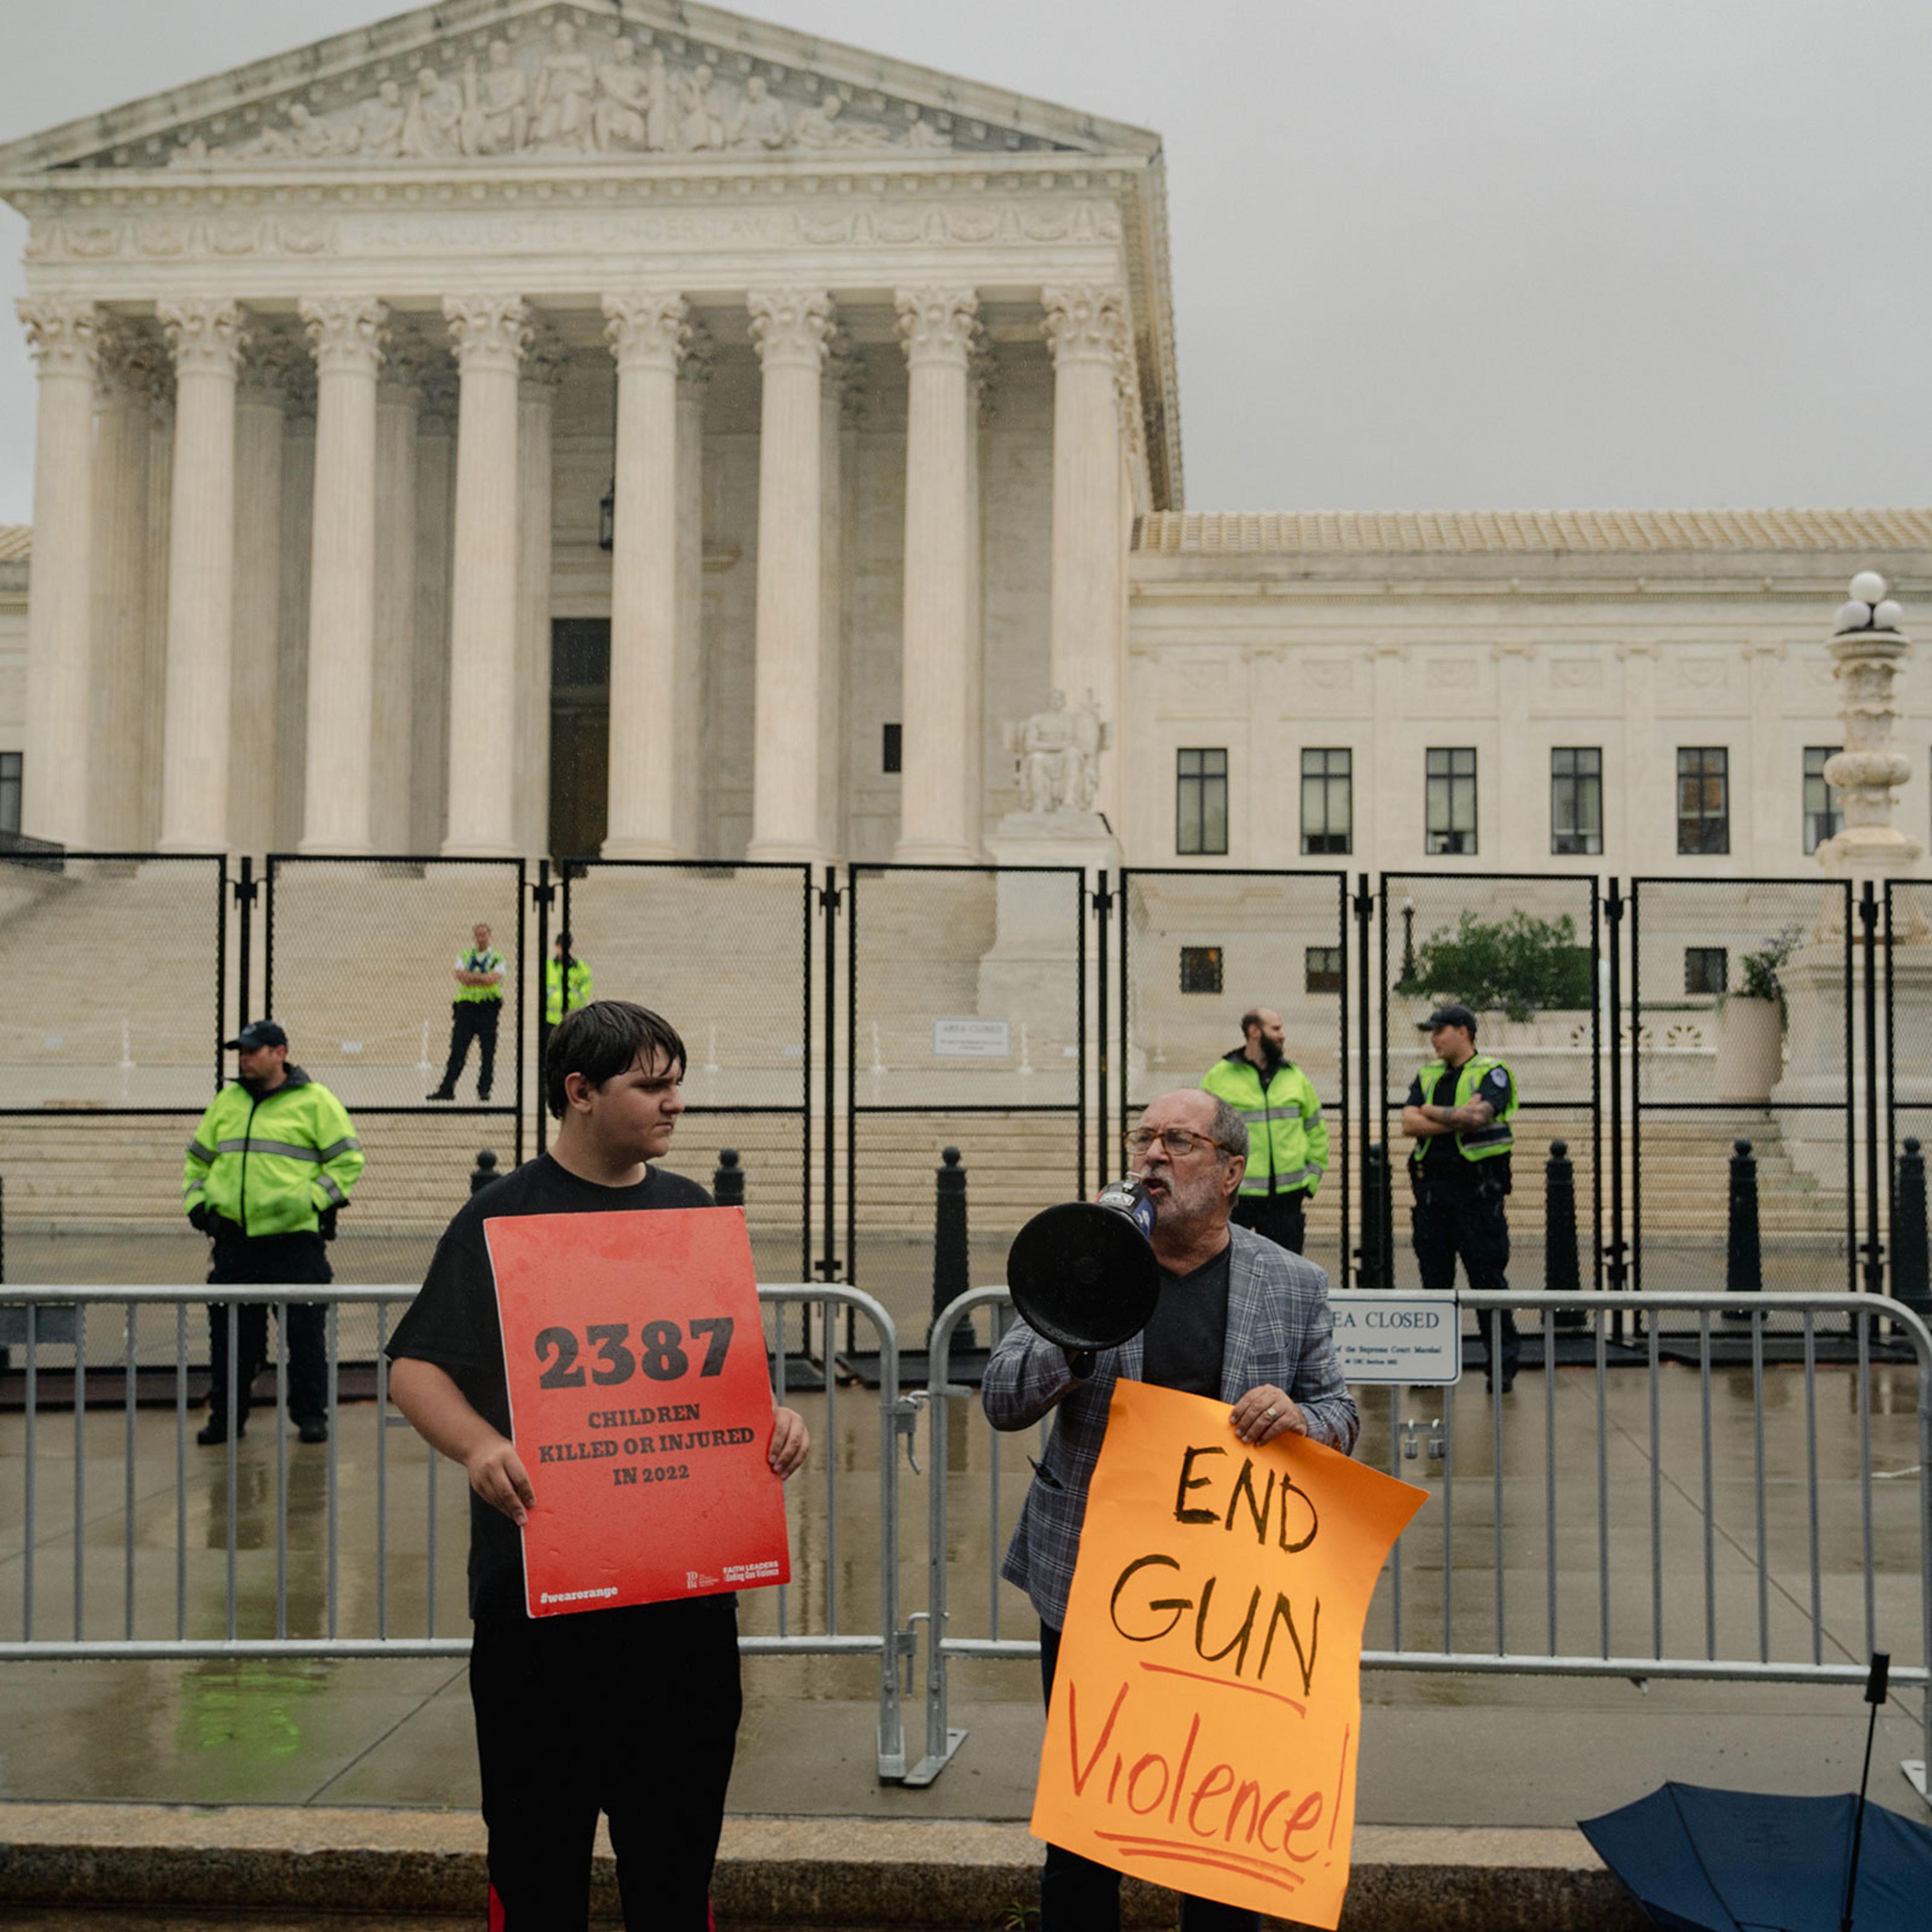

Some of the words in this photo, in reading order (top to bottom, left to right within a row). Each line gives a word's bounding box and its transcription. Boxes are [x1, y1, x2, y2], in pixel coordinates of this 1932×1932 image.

[1333, 1311, 1356, 1328] EA
[1365, 1312, 1439, 1328] CLOSED
[534, 1317, 734, 1390] 2387
[588, 1404, 700, 1428] CHILDREN
[539, 1440, 618, 1464] KILLED
[624, 1436, 655, 1455] OR
[659, 1427, 754, 1452] INJURED
[613, 1467, 637, 1485] IN
[642, 1465, 689, 1483] 2022
[1173, 1446, 1318, 1554] END
[723, 1565, 744, 1573] FAITH
[746, 1561, 779, 1571] LEADERS
[540, 1587, 618, 1604] #wearorange
[1110, 1554, 1320, 1697] GUN
[1069, 1679, 1350, 1867] Violence!
